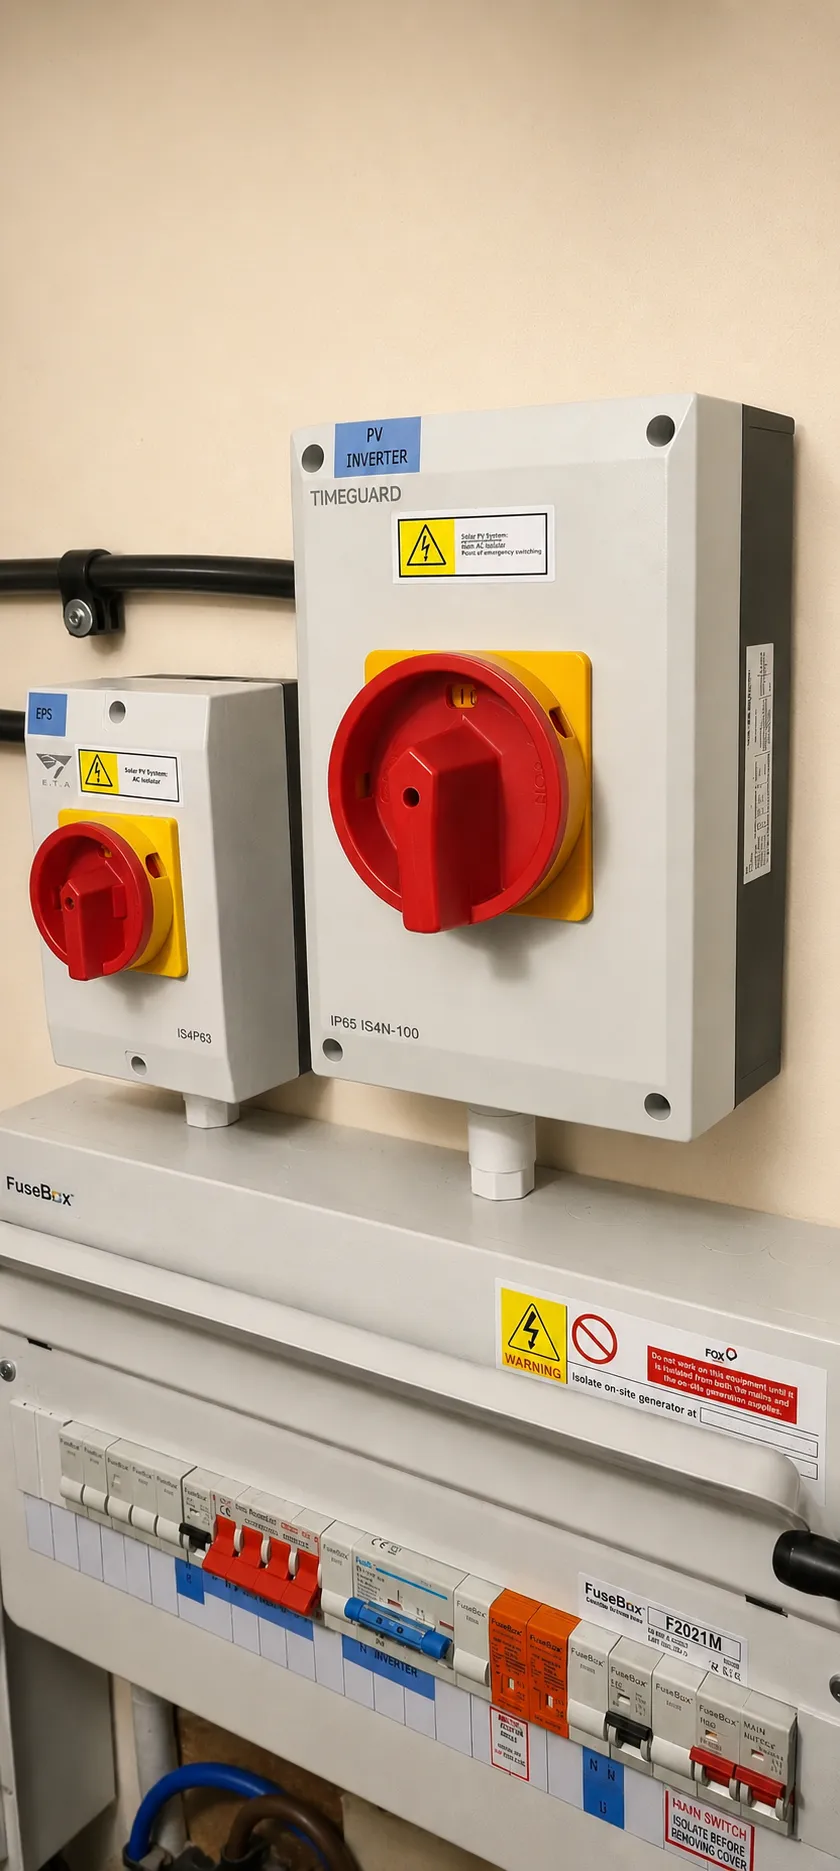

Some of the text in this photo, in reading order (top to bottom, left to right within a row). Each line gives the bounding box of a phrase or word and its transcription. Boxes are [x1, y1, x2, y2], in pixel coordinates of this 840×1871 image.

[366, 427, 383, 443] PV
[346, 449, 408, 468] INVERTER
[310, 486, 402, 506] TIMEGUARD
[484, 549, 514, 557] emergency
[35, 707, 53, 721] EPS
[177, 1027, 213, 1044] IS4P63
[330, 1015, 419, 1039] IP65 IS4N-100
[505, 1353, 561, 1379] WARNING
[705, 1348, 725, 1361] FOX
[651, 1352, 662, 1361] Do
[663, 1357, 676, 1365] not
[678, 1360, 696, 1371] work
[698, 1367, 708, 1375] on
[710, 1369, 724, 1379] this
[769, 1386, 786, 1397] until
[572, 1372, 697, 1419] Isolate on-site generator at
[694, 1374, 713, 1385] from
[714, 1378, 732, 1391] both
[774, 1398, 789, 1408] and
[666, 1615, 722, 1651] F2021M
[374, 1650, 418, 1678] INVERTER
[673, 1814, 745, 1858] ISOLATE BEFORE
[704, 1812, 747, 1842] SWITCH
[717, 1849, 747, 1871] COVER
